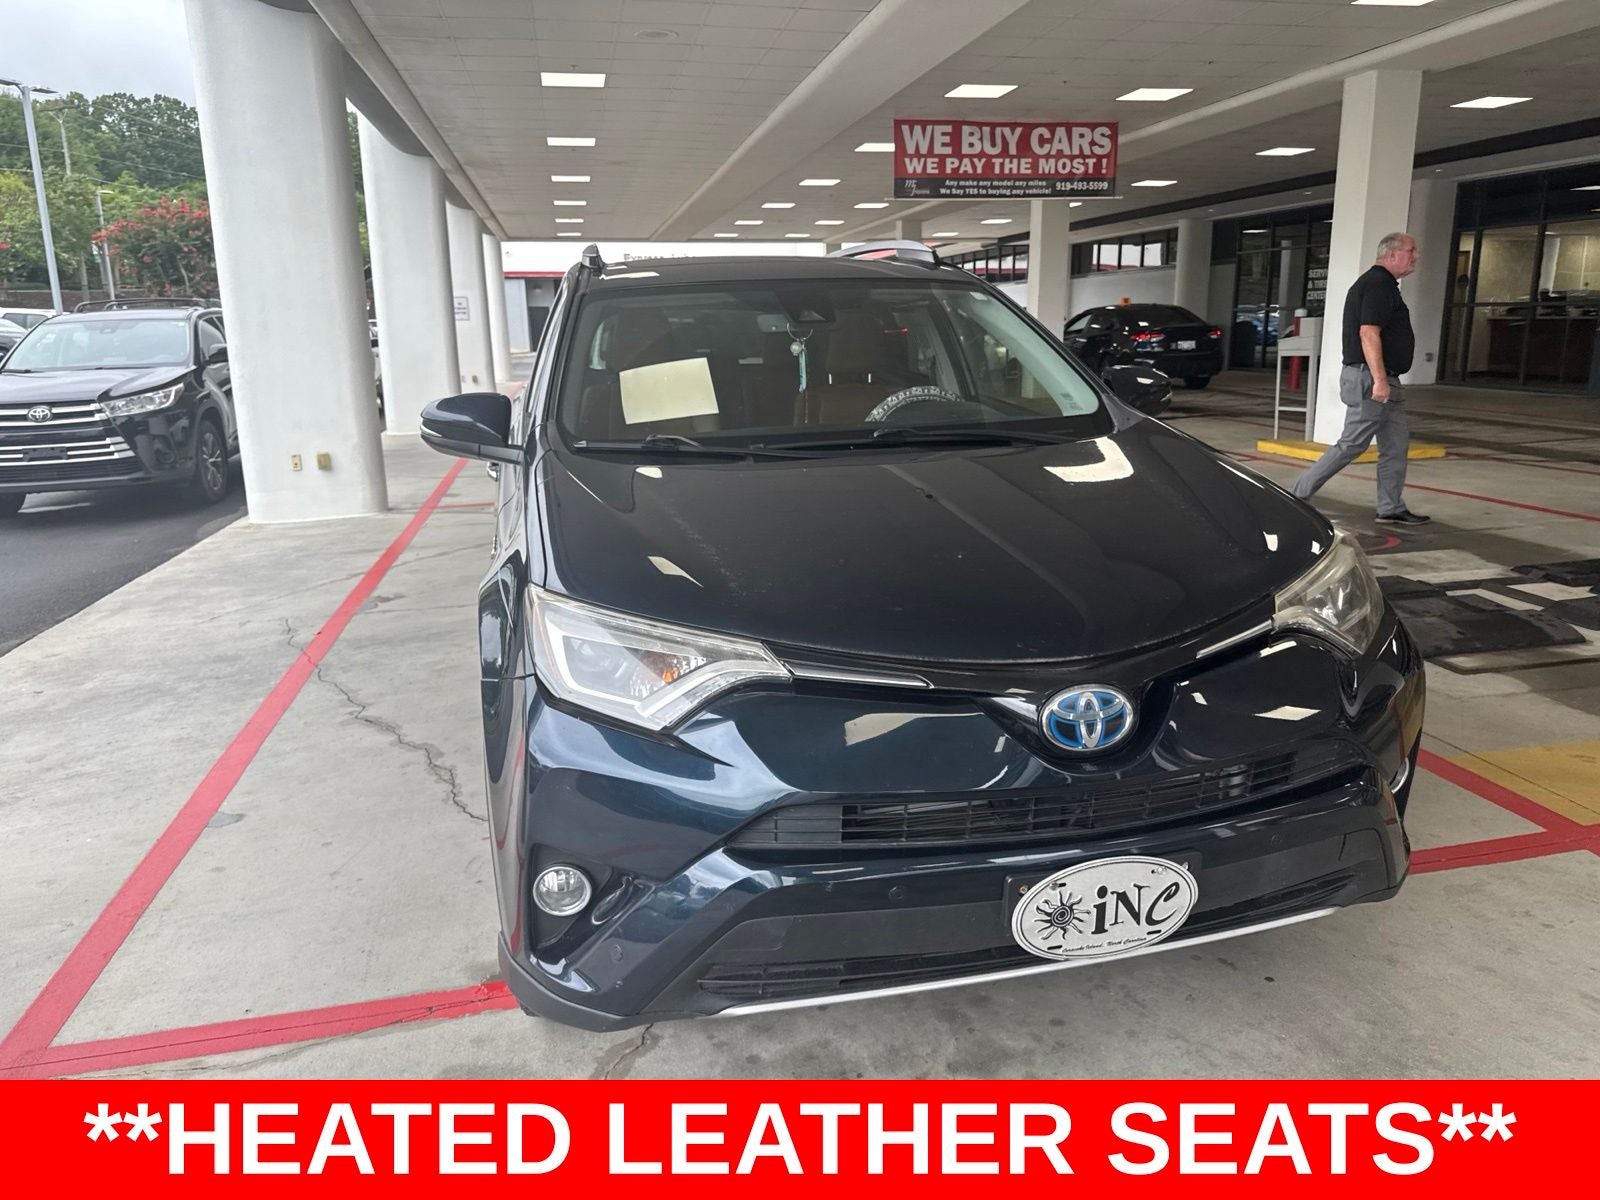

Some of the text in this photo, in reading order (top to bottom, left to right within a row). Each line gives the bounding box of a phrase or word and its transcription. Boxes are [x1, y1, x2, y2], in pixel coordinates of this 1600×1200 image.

[901, 125, 1112, 156] WE BUY CARS
[904, 158, 939, 174] WE
[945, 158, 986, 174] PAY
[992, 158, 1032, 174] THE
[1038, 158, 1096, 174] MOST
[951, 188, 964, 196] Say
[988, 188, 1011, 196] buying
